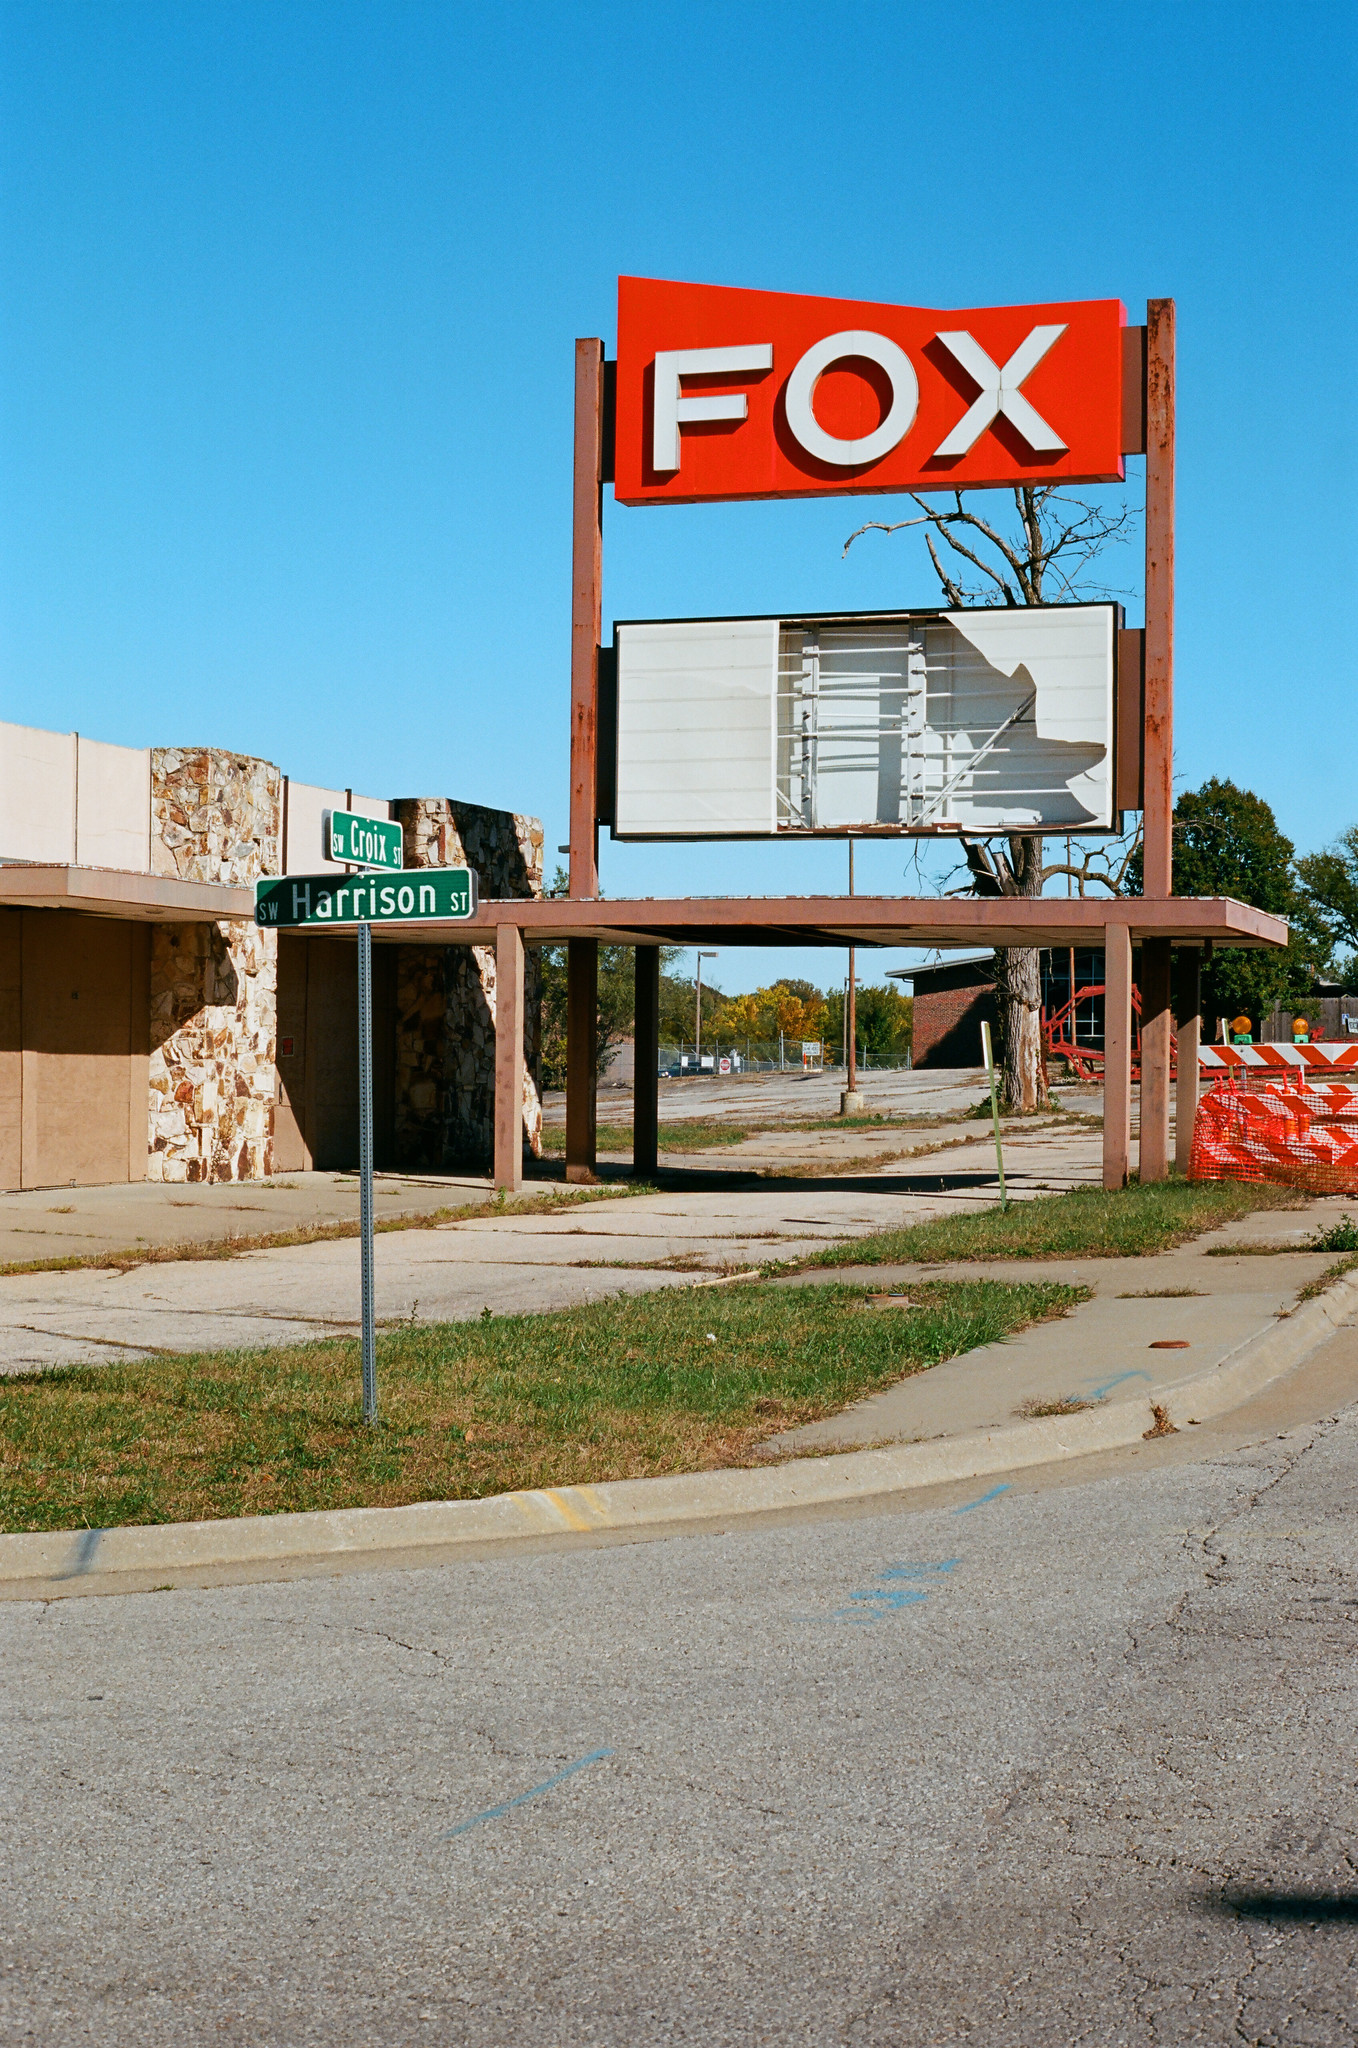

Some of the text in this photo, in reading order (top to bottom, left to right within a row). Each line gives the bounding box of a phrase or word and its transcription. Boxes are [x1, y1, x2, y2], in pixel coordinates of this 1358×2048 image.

[652, 323, 1070, 472] FOX
[333, 820, 401, 865] SW Croix ST
[259, 879, 468, 920] SW Harrison ST
